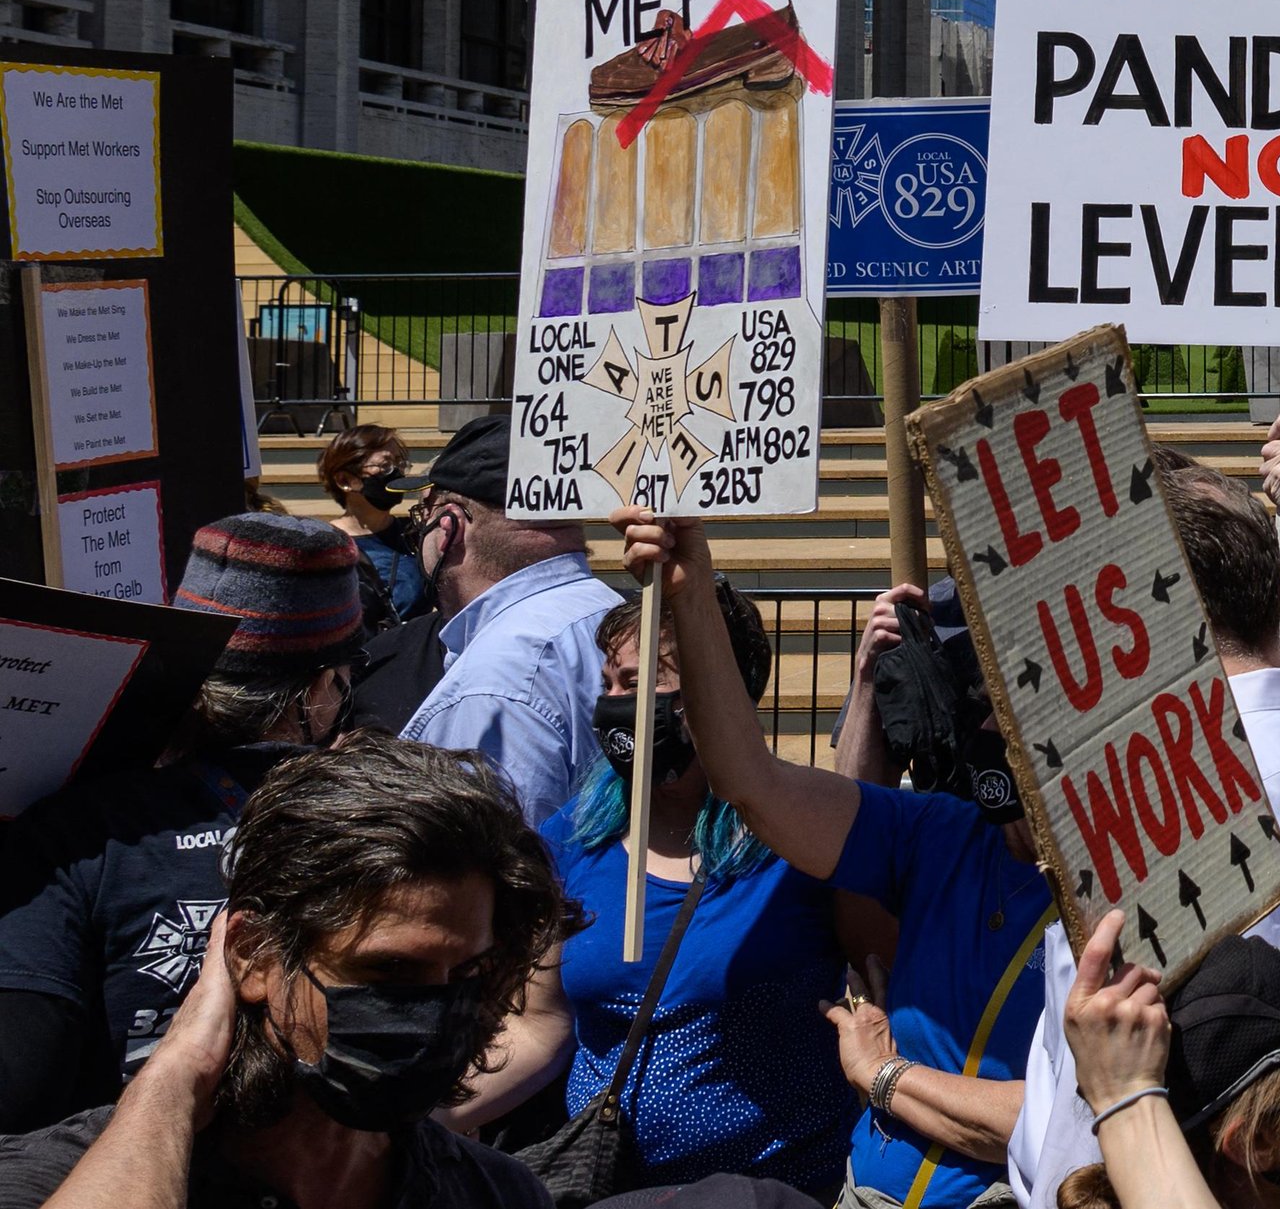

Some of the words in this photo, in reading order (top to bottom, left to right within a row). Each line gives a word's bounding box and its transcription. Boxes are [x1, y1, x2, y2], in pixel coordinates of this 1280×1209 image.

[33, 92, 52, 107] We
[57, 92, 76, 108] Are
[80, 93, 98, 109] the
[102, 94, 123, 110] Met
[22, 139, 65, 159] Support
[69, 141, 90, 156] Met
[92, 141, 140, 157] Workers
[917, 152, 951, 161] LOCAL
[916, 162, 978, 186] USA
[36, 189, 61, 207] Stop
[64, 188, 131, 207] Outsourcing
[894, 173, 976, 230] 829
[59, 212, 111, 228] Overseas
[856, 261, 929, 277] SCENIC
[57, 308, 67, 317] We
[69, 307, 86, 317] Make
[87, 306, 97, 316] the
[98, 305, 110, 315] Met
[111, 305, 126, 316] Sing
[741, 309, 792, 342] USA
[66, 335, 76, 344] We
[78, 334, 96, 343] Dress
[97, 332, 106, 341] the
[108, 331, 120, 340] Met
[530, 321, 596, 353] LOCAL
[63, 362, 73, 371] We
[75, 360, 102, 370] Make-Up
[104, 358, 113, 367] the
[114, 357, 126, 366] Met
[750, 337, 796, 374] 829
[538, 354, 586, 385] ONE
[651, 367, 672, 384] WE
[70, 388, 81, 397] We
[82, 386, 97, 396] Build
[99, 385, 108, 394] the
[110, 384, 122, 393] Met
[646, 385, 673, 404] ARE
[739, 376, 795, 422] 798
[515, 392, 568, 437] 764
[650, 401, 673, 412] THE
[74, 415, 85, 424] We
[86, 413, 97, 422] Set
[98, 411, 108, 420] the
[109, 410, 121, 419] Met
[640, 412, 674, 438] MET
[74, 442, 84, 451] We
[86, 440, 101, 449] Paint
[102, 438, 112, 447] the
[113, 436, 125, 445] Met
[544, 433, 593, 475] 751
[976, 382, 1119, 567] LET
[507, 475, 583, 511] AGMA
[634, 474, 669, 513] 817
[699, 466, 763, 509] 32BJ
[83, 504, 126, 527] Protect
[81, 536, 105, 554] The
[108, 529, 131, 546] Met
[94, 559, 122, 578] from
[114, 579, 142, 599] Gelb
[1037, 564, 1151, 713] US
[2, 696, 60, 715] MET
[980, 783, 1005, 802] 829
[1061, 676, 1261, 903] WORK
